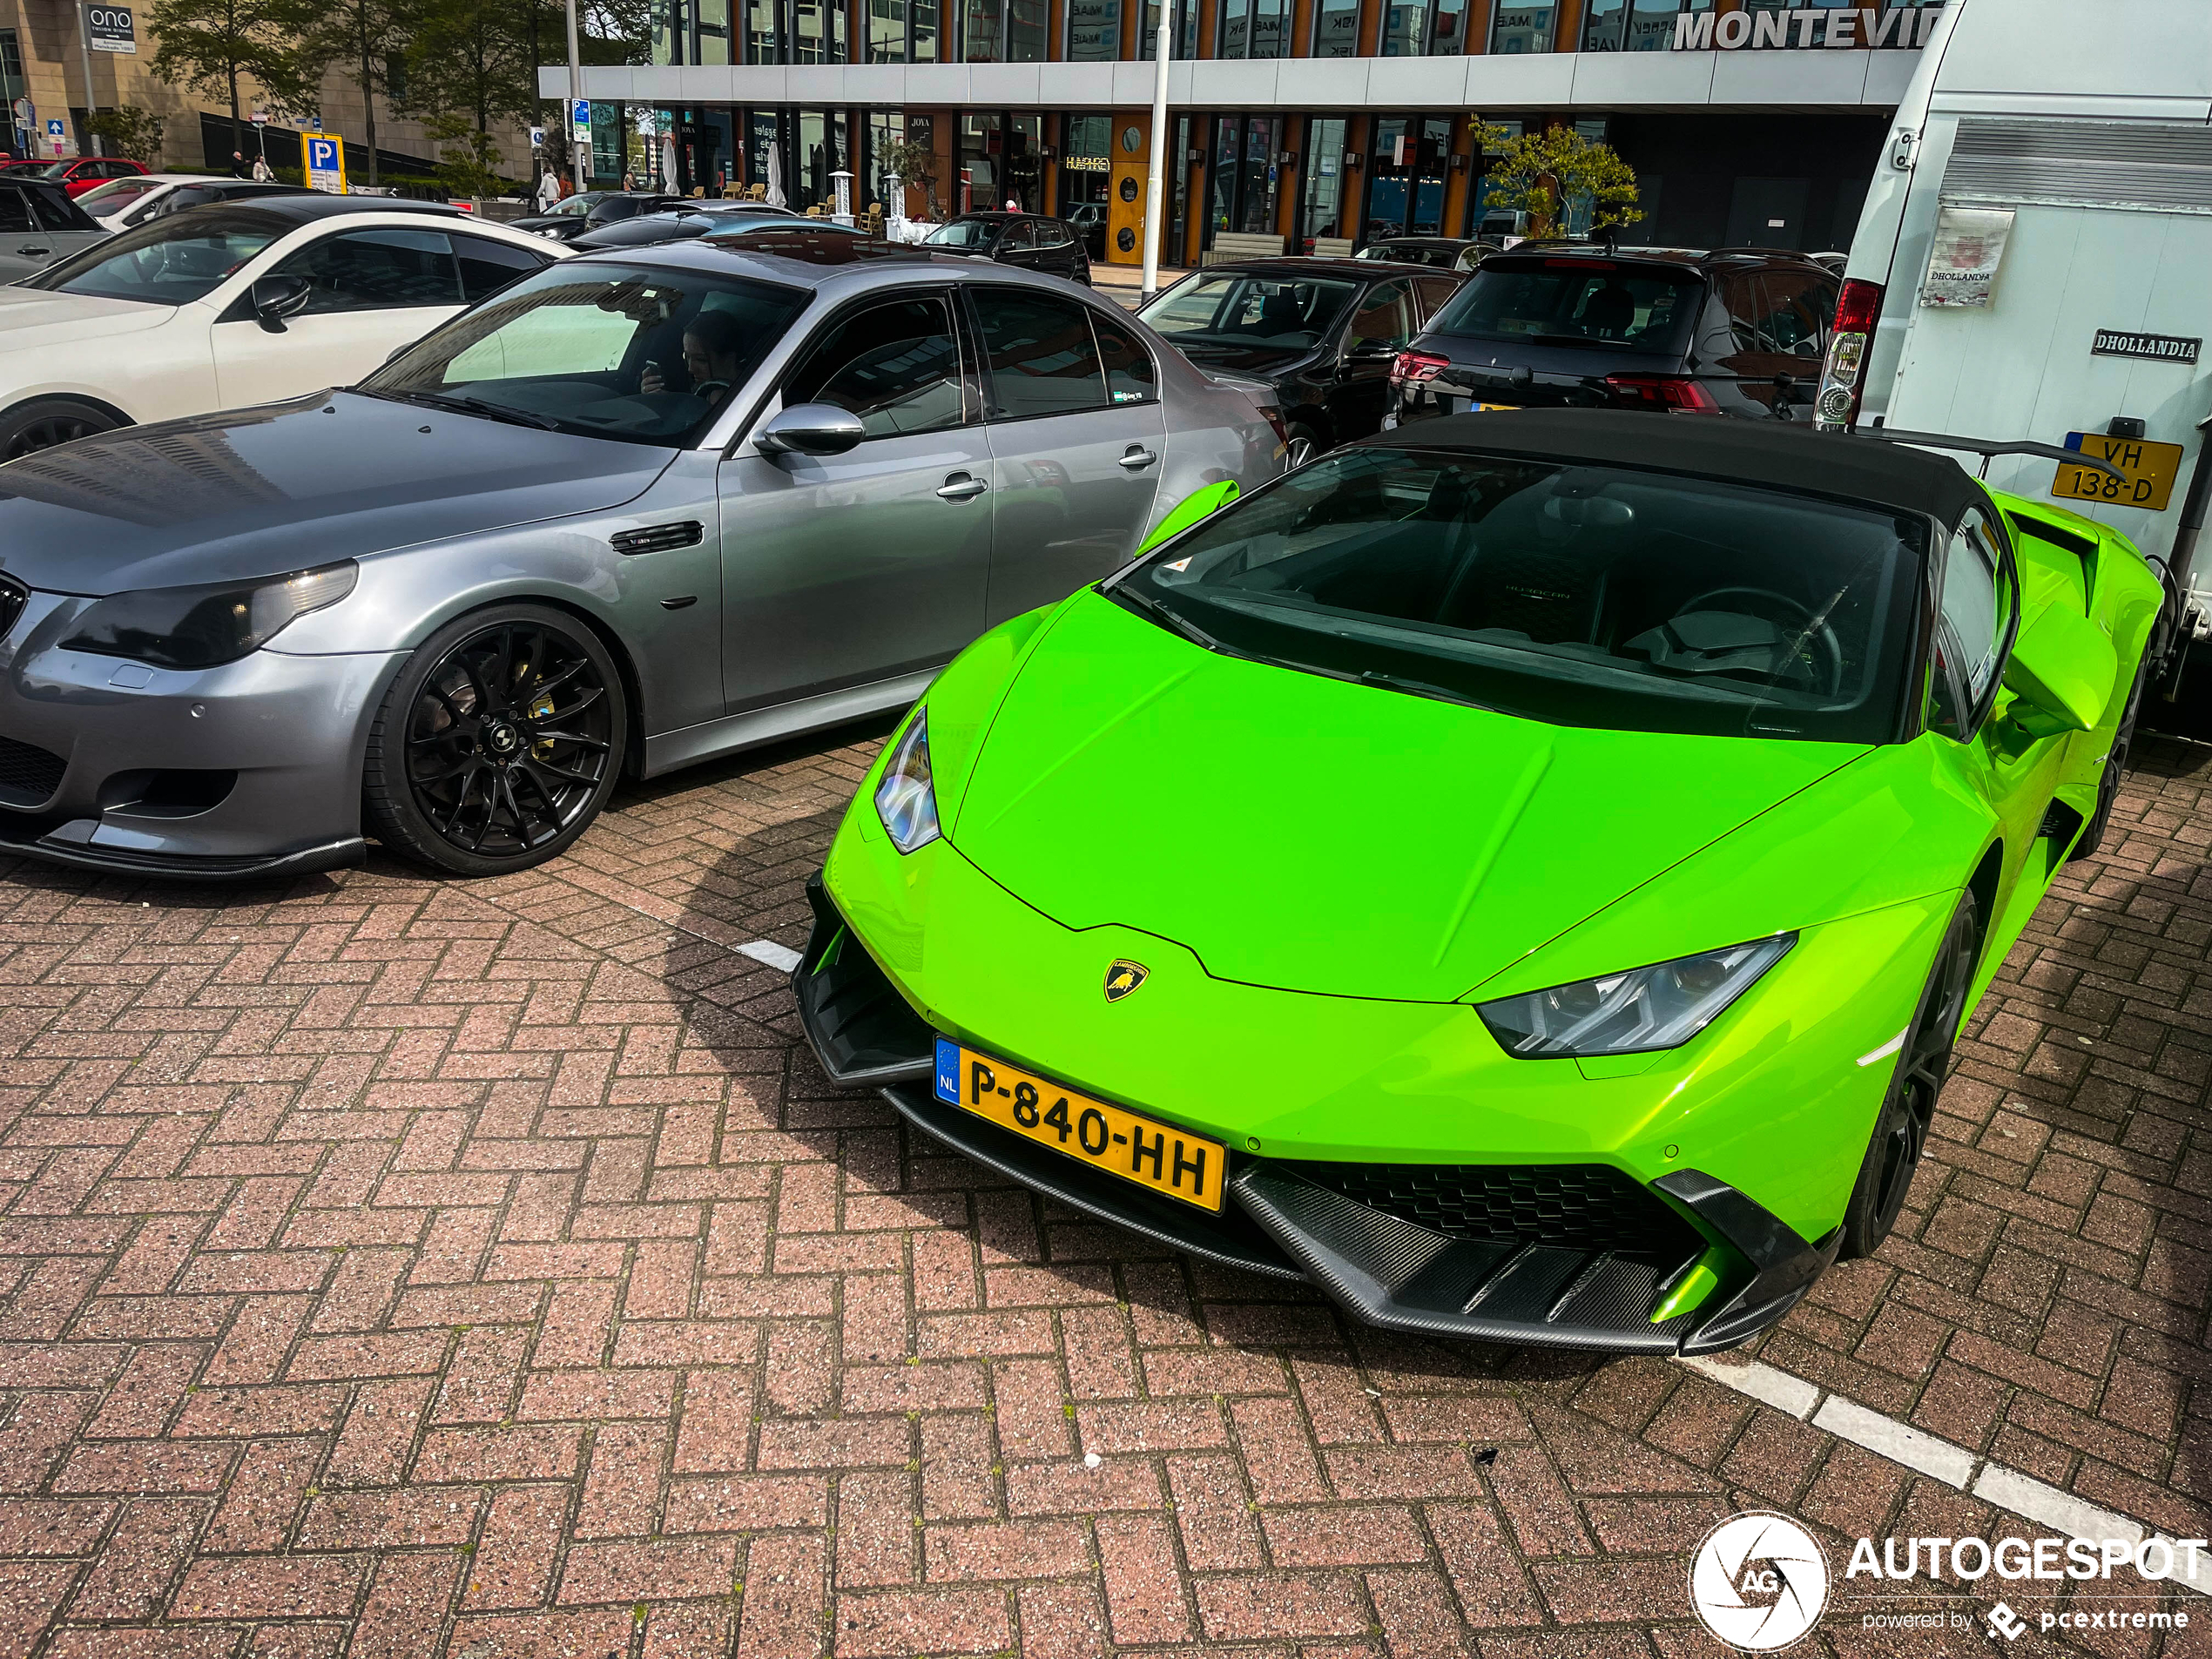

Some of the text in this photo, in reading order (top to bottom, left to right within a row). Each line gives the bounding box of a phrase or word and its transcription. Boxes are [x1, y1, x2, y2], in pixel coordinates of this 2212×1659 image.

[681, 125, 696, 134] JOYA
[911, 118, 930, 127] JOYA
[314, 141, 333, 167] P
[1931, 271, 1990, 281] DHOLLANDIA
[2094, 334, 2195, 358] DHOLLANDIA
[2104, 441, 2143, 469] VH
[2072, 470, 2154, 502] 138-D
[940, 1074, 957, 1094] NL
[971, 1060, 1207, 1197] P-840-HH
